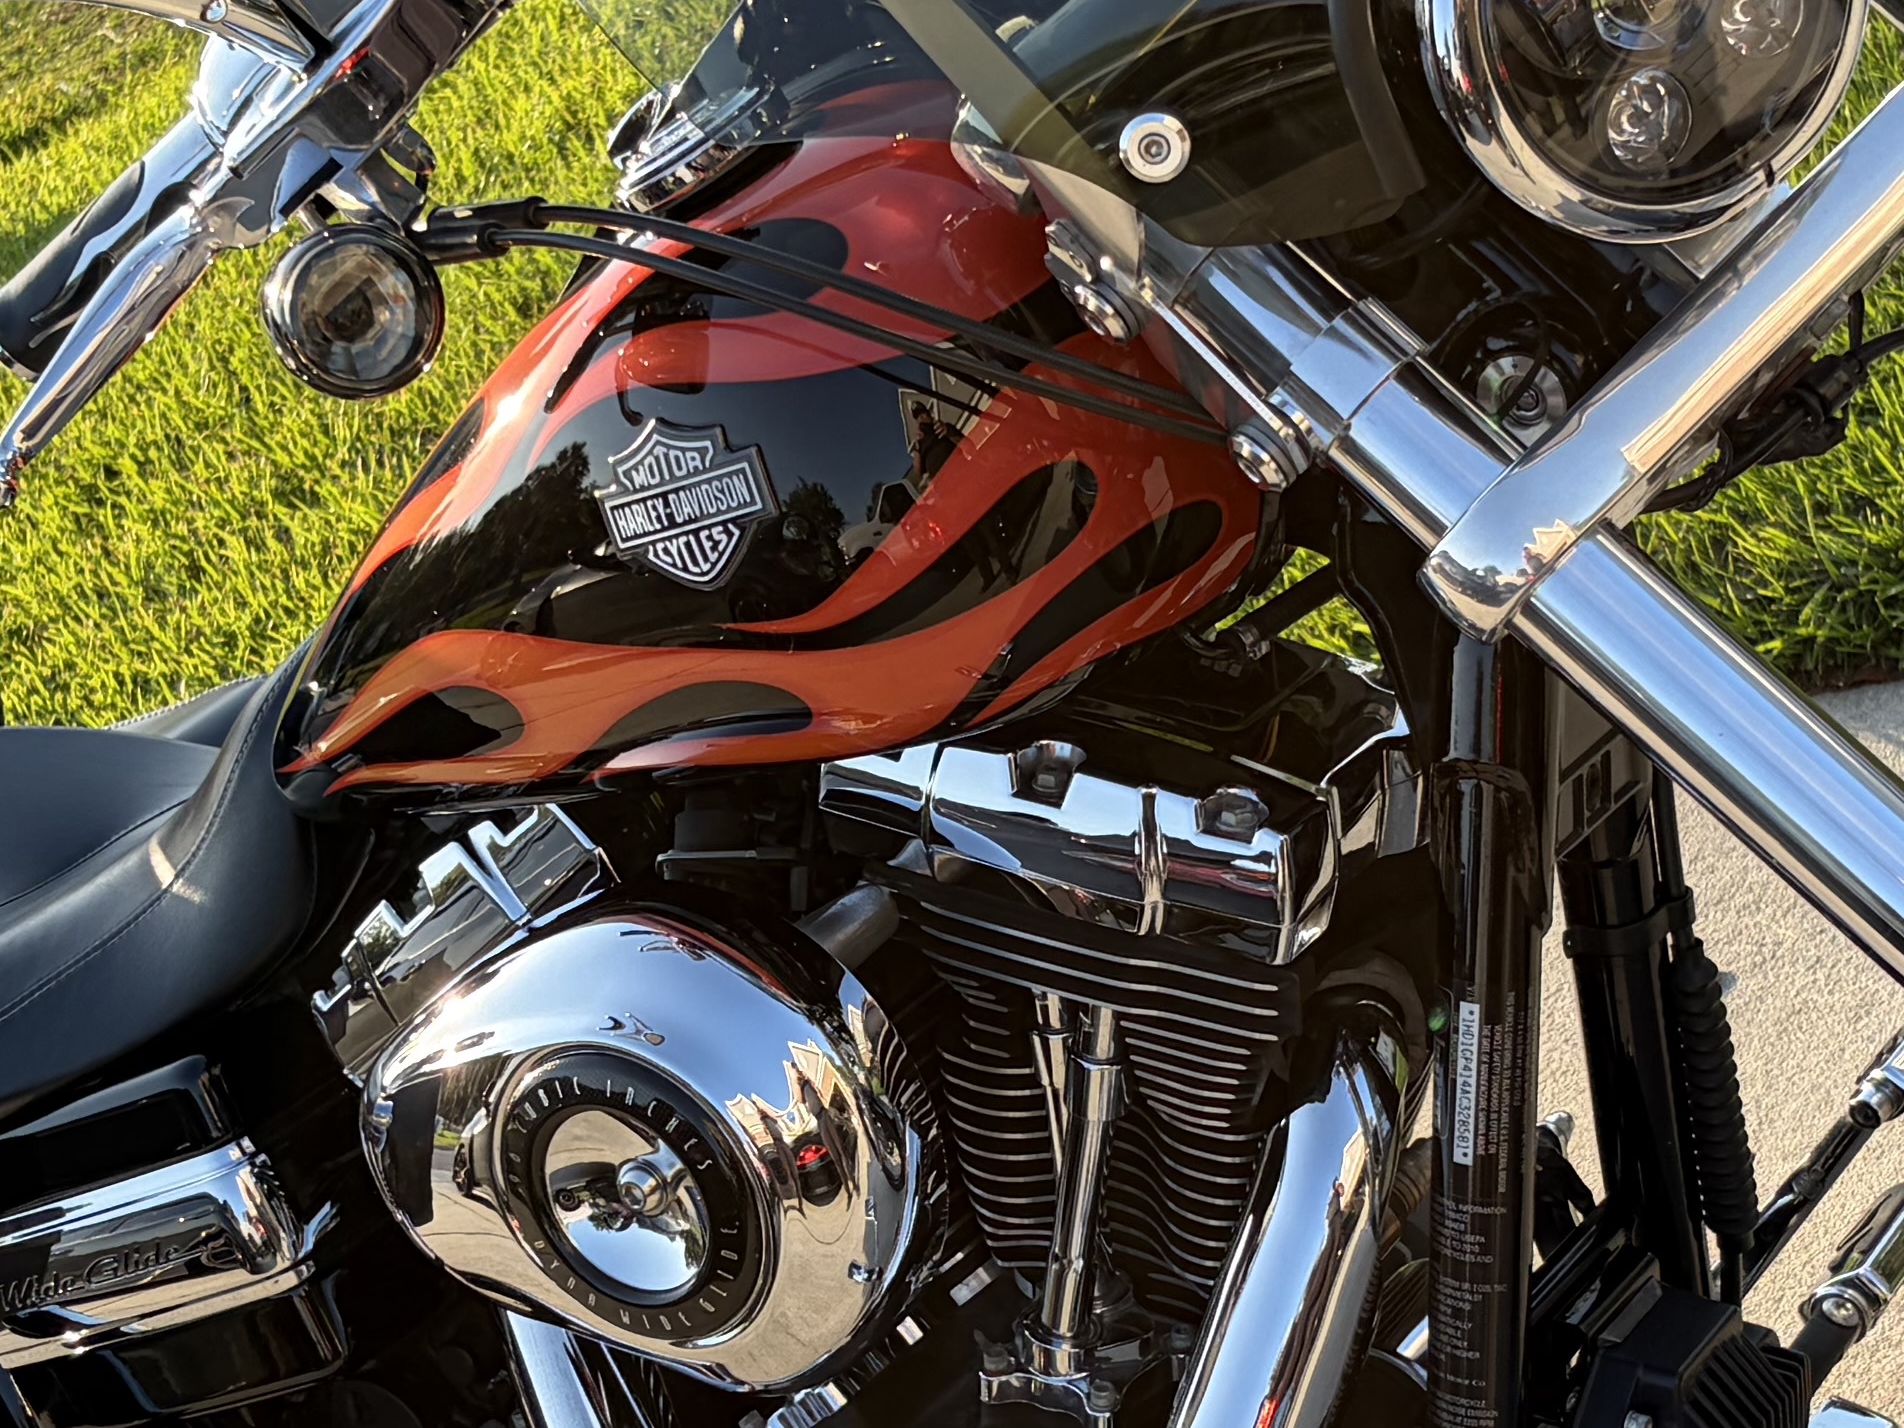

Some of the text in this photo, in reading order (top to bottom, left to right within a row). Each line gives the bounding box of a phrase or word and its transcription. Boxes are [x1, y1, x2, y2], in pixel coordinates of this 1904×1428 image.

[631, 446, 703, 489] MOTOR
[613, 474, 751, 538] HARLEY-DAVIDSON
[656, 525, 729, 573] CYCLES
[514, 1076, 582, 1134] CUBIC
[605, 1079, 713, 1172] INCHES
[82, 1241, 180, 1289] Glide
[534, 1239, 598, 1308] DYNA
[618, 1308, 693, 1332] WIDE
